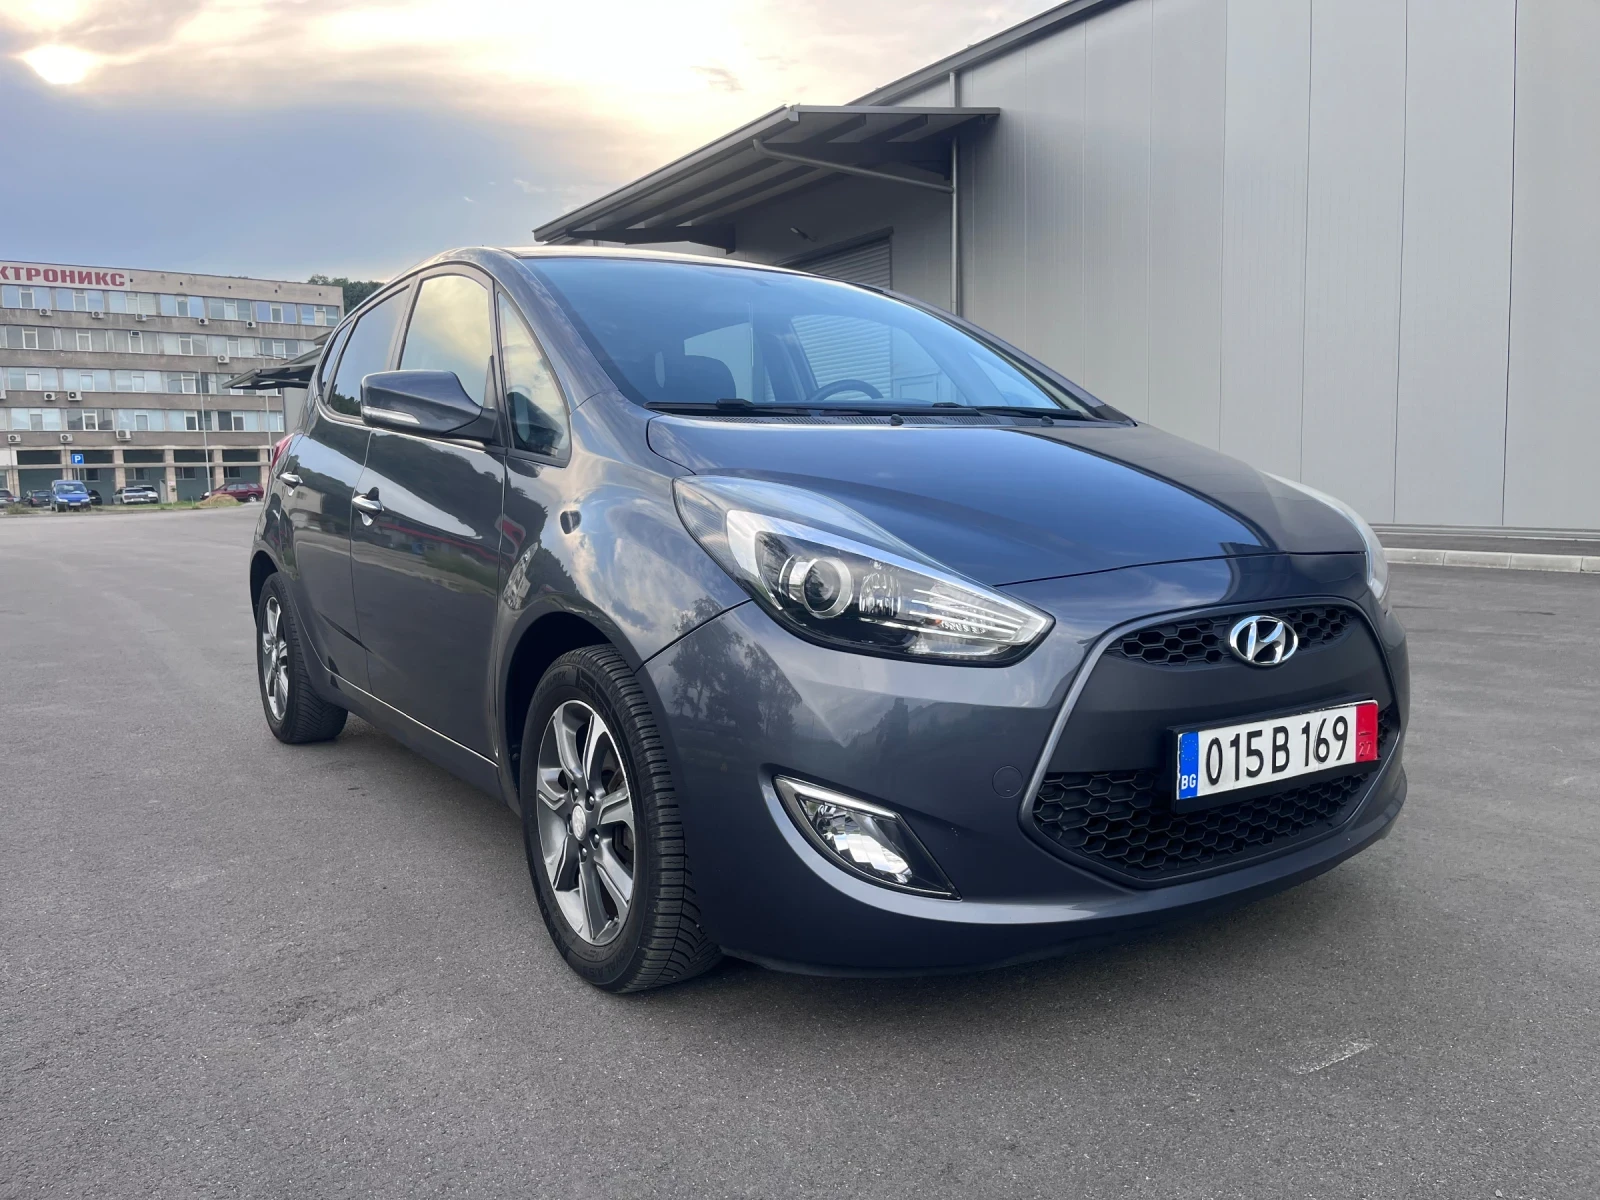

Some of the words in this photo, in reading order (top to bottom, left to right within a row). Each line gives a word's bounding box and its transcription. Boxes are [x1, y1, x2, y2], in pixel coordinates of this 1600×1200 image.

[74, 455, 82, 463] P
[1301, 715, 1349, 768] 169
[1181, 773, 1197, 790] BG
